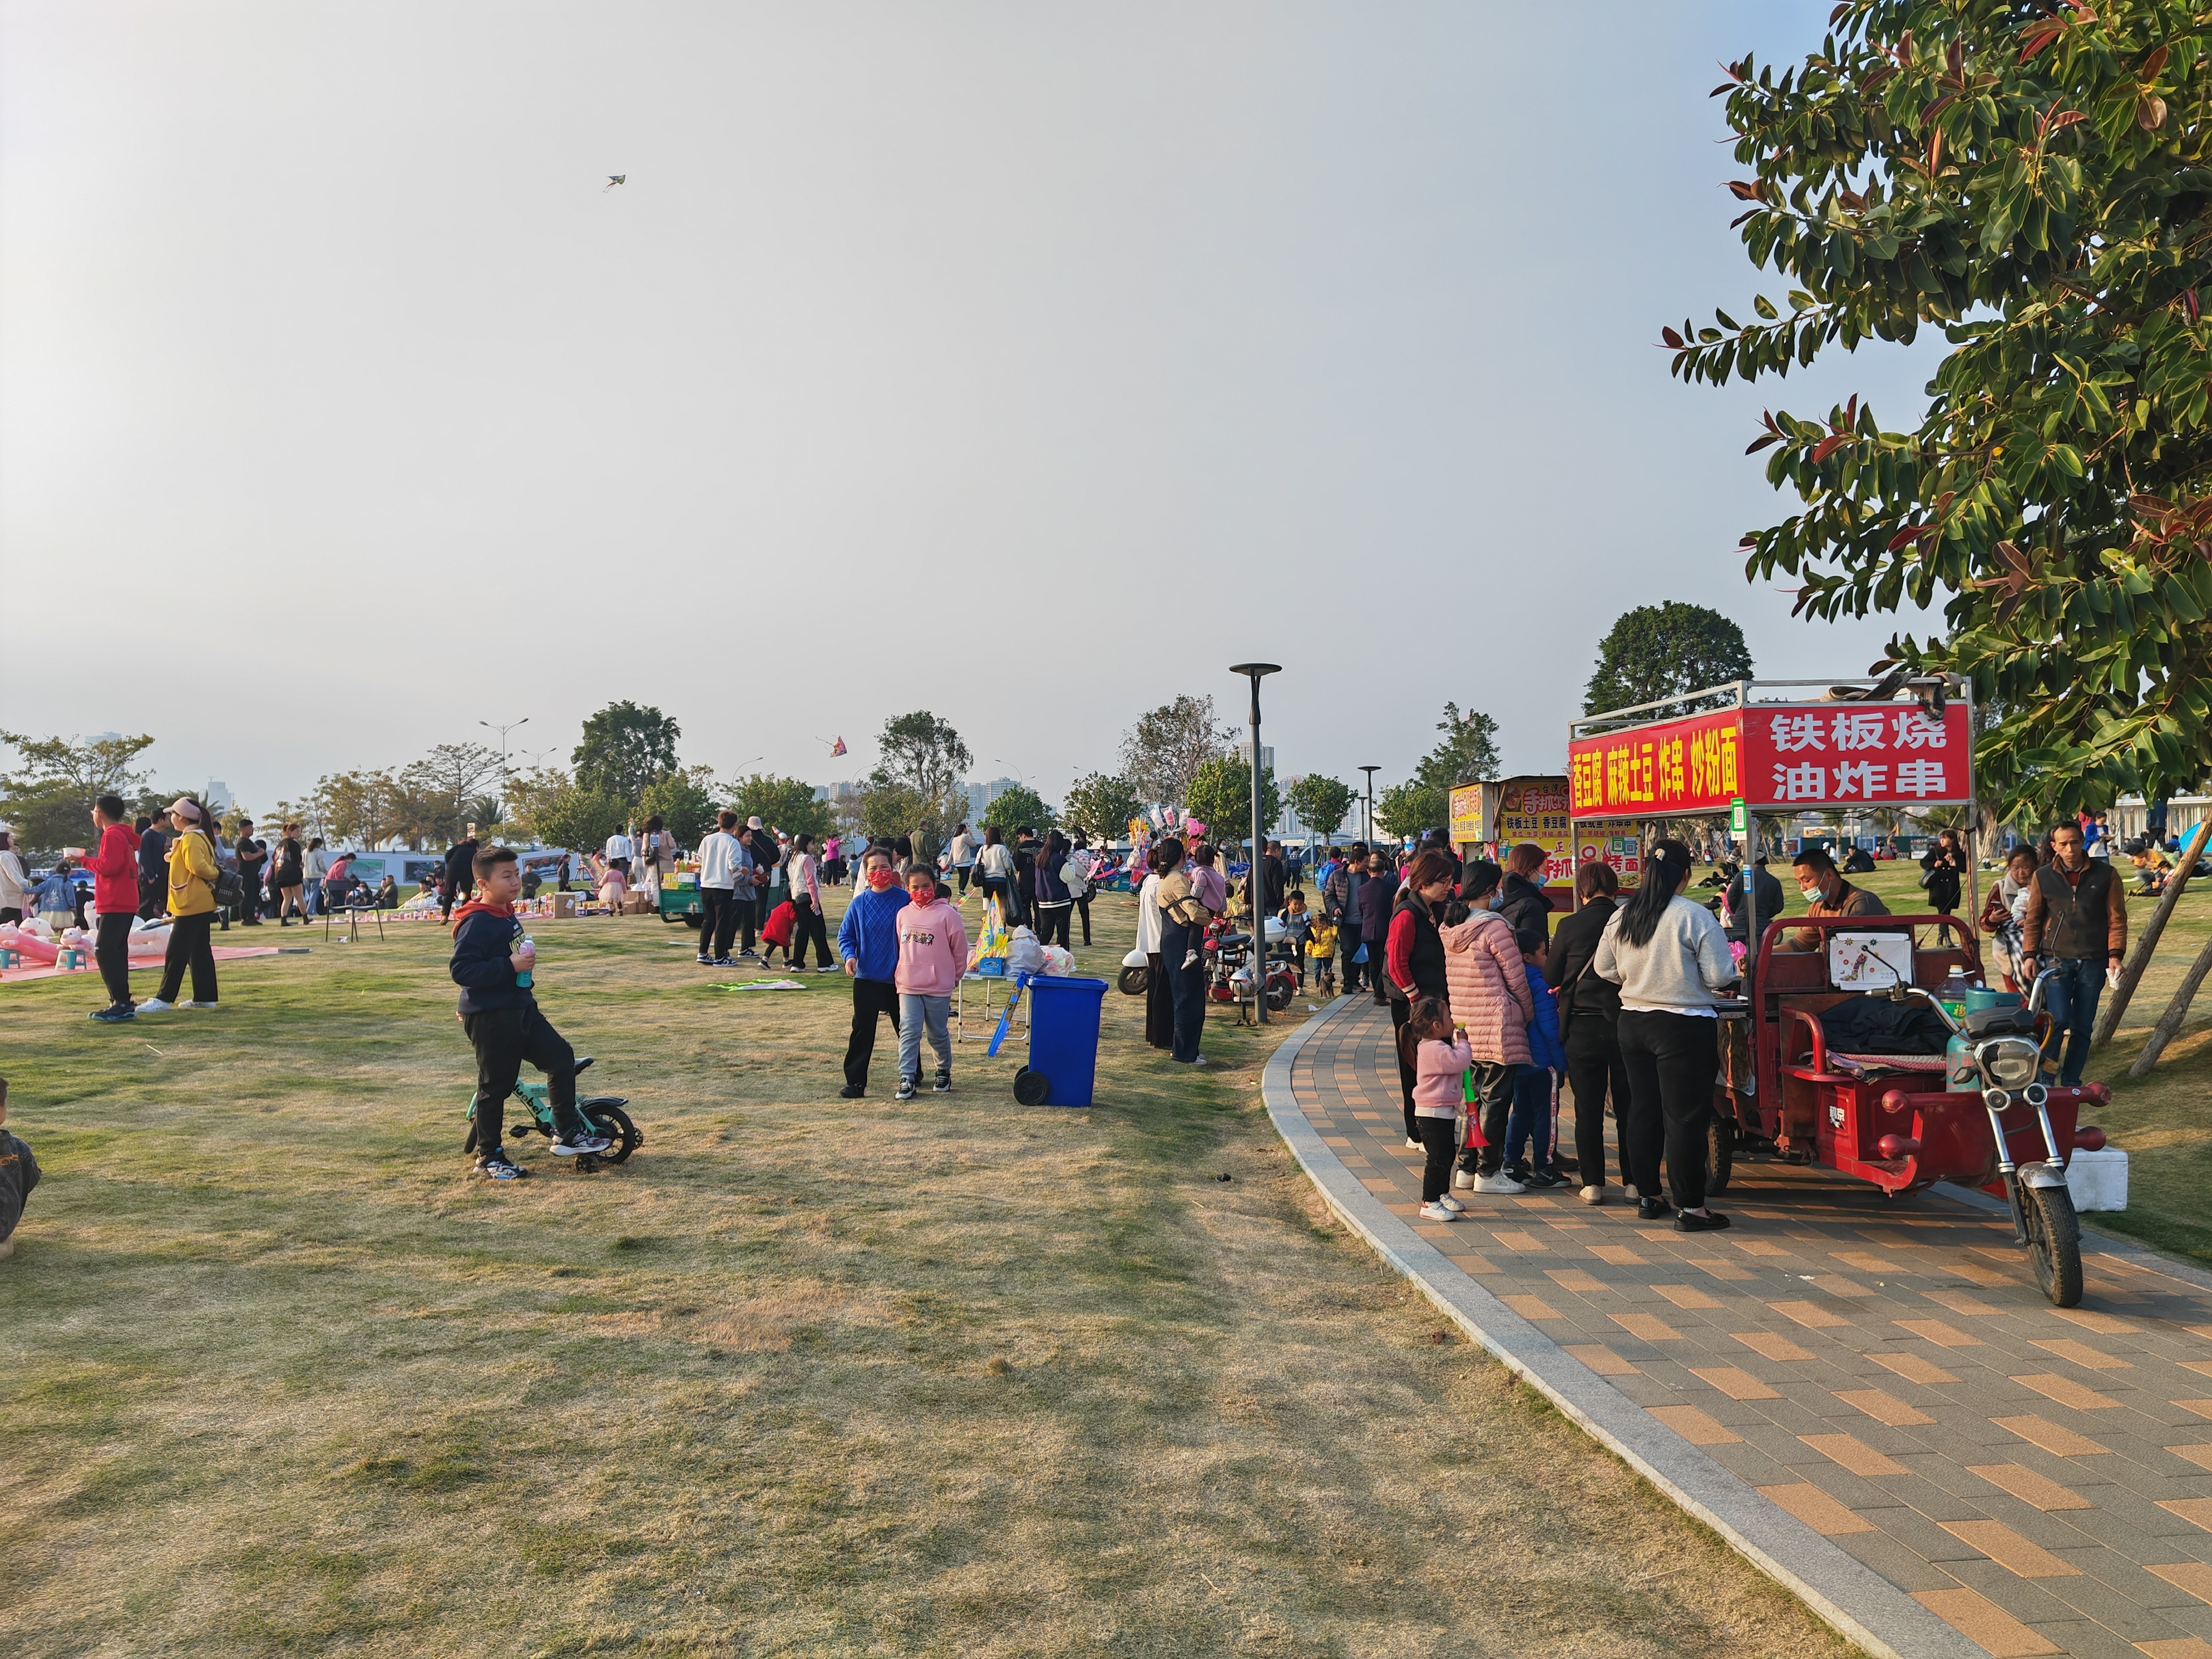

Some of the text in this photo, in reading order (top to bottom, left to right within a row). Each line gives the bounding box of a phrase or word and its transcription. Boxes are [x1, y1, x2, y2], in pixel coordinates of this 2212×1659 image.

[1769, 711, 1947, 752] 铁板烧
[1573, 726, 1737, 809] 香豆腐 麻辣土豆 炸串 炒粉面
[1771, 759, 1946, 800] 油炸串
[1506, 816, 1538, 829] 铁板土豆
[1543, 816, 1566, 829] 香豆腐
